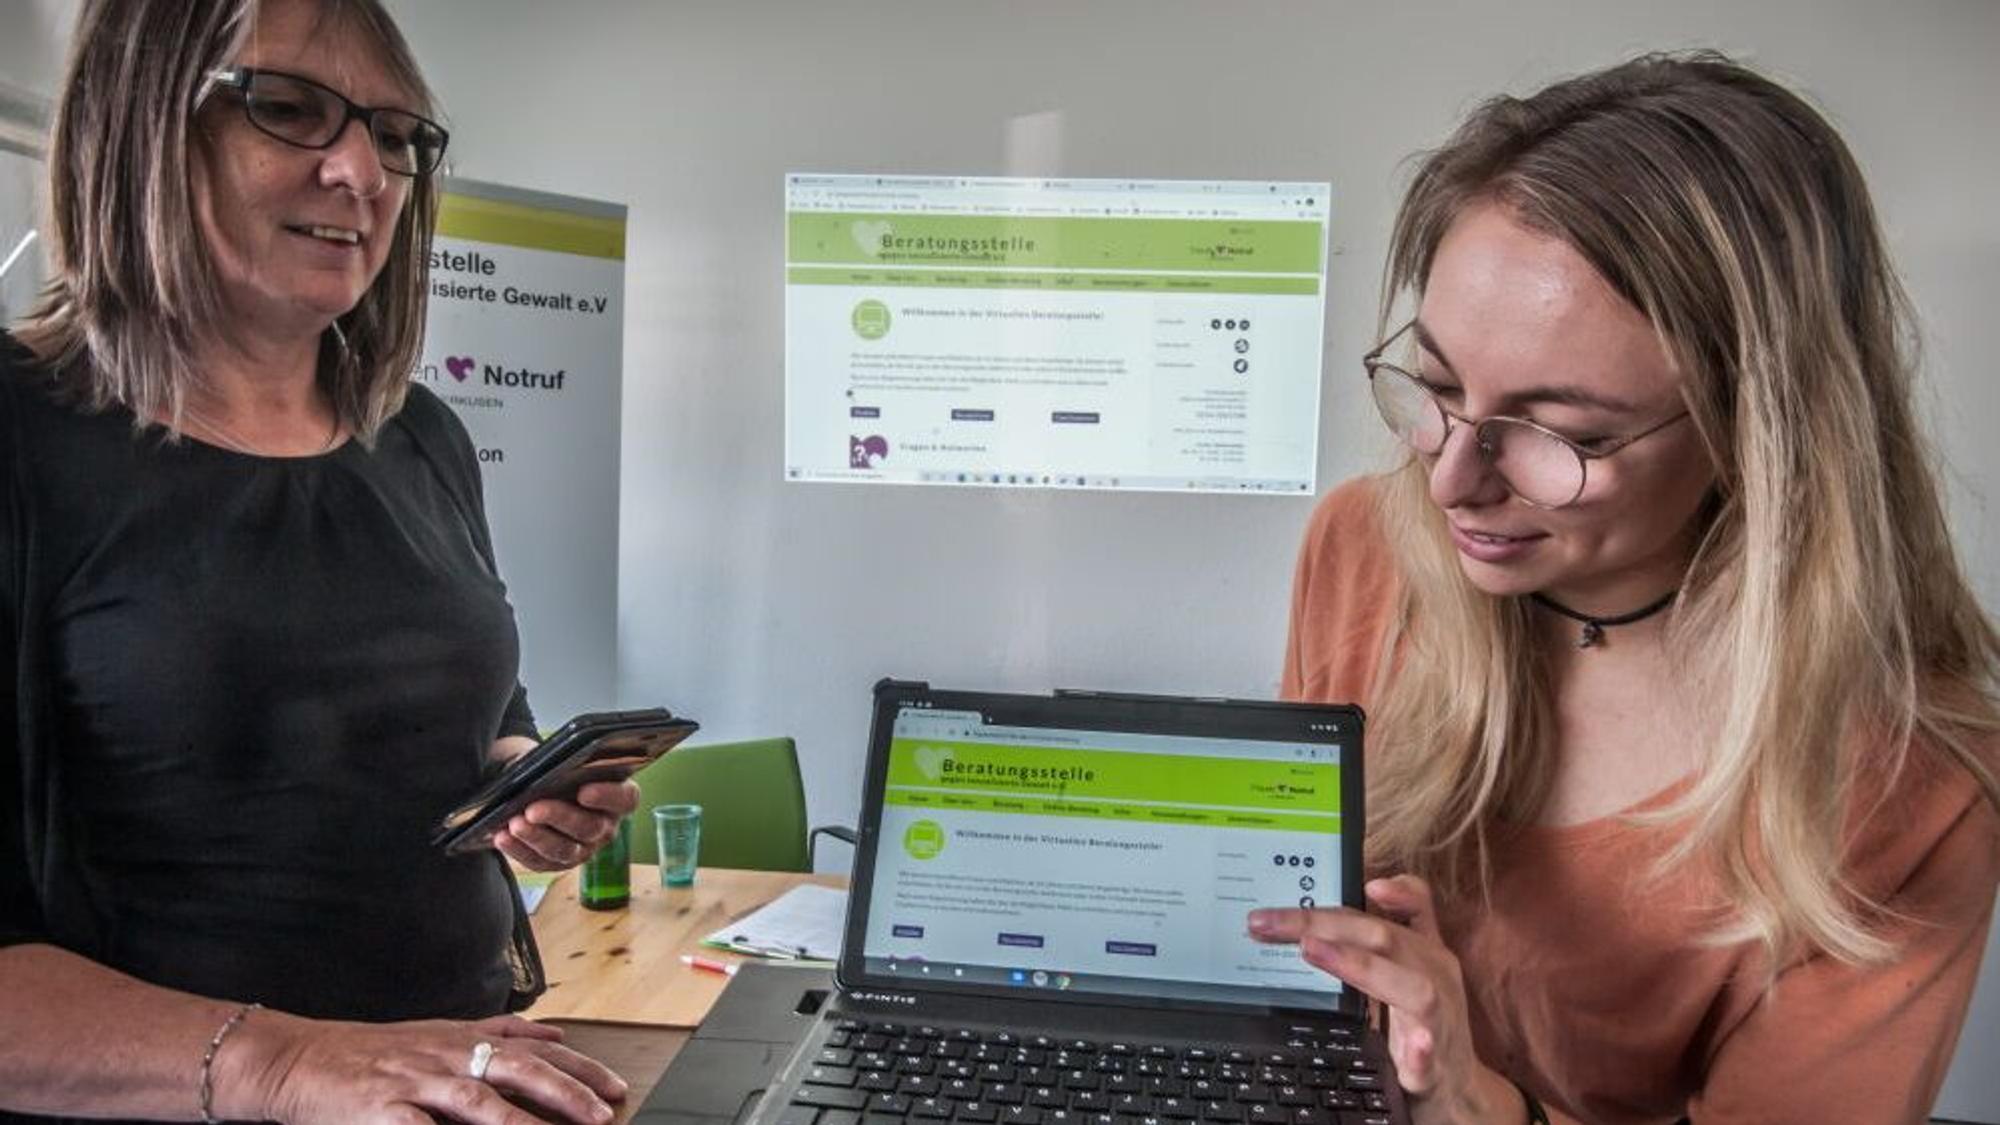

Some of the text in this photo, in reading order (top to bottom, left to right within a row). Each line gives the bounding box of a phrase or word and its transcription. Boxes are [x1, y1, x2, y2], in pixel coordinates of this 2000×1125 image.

[881, 234, 1036, 253] Beratungsstelle
[428, 250, 496, 276] stelle
[432, 279, 608, 314] isierte Gewalt e.V
[484, 365, 566, 390] Notruf
[478, 447, 503, 463] on
[943, 758, 1095, 782] Beratungsstelle
[956, 829, 1010, 840] Willkommen
[865, 993, 916, 1004] FINTIE
